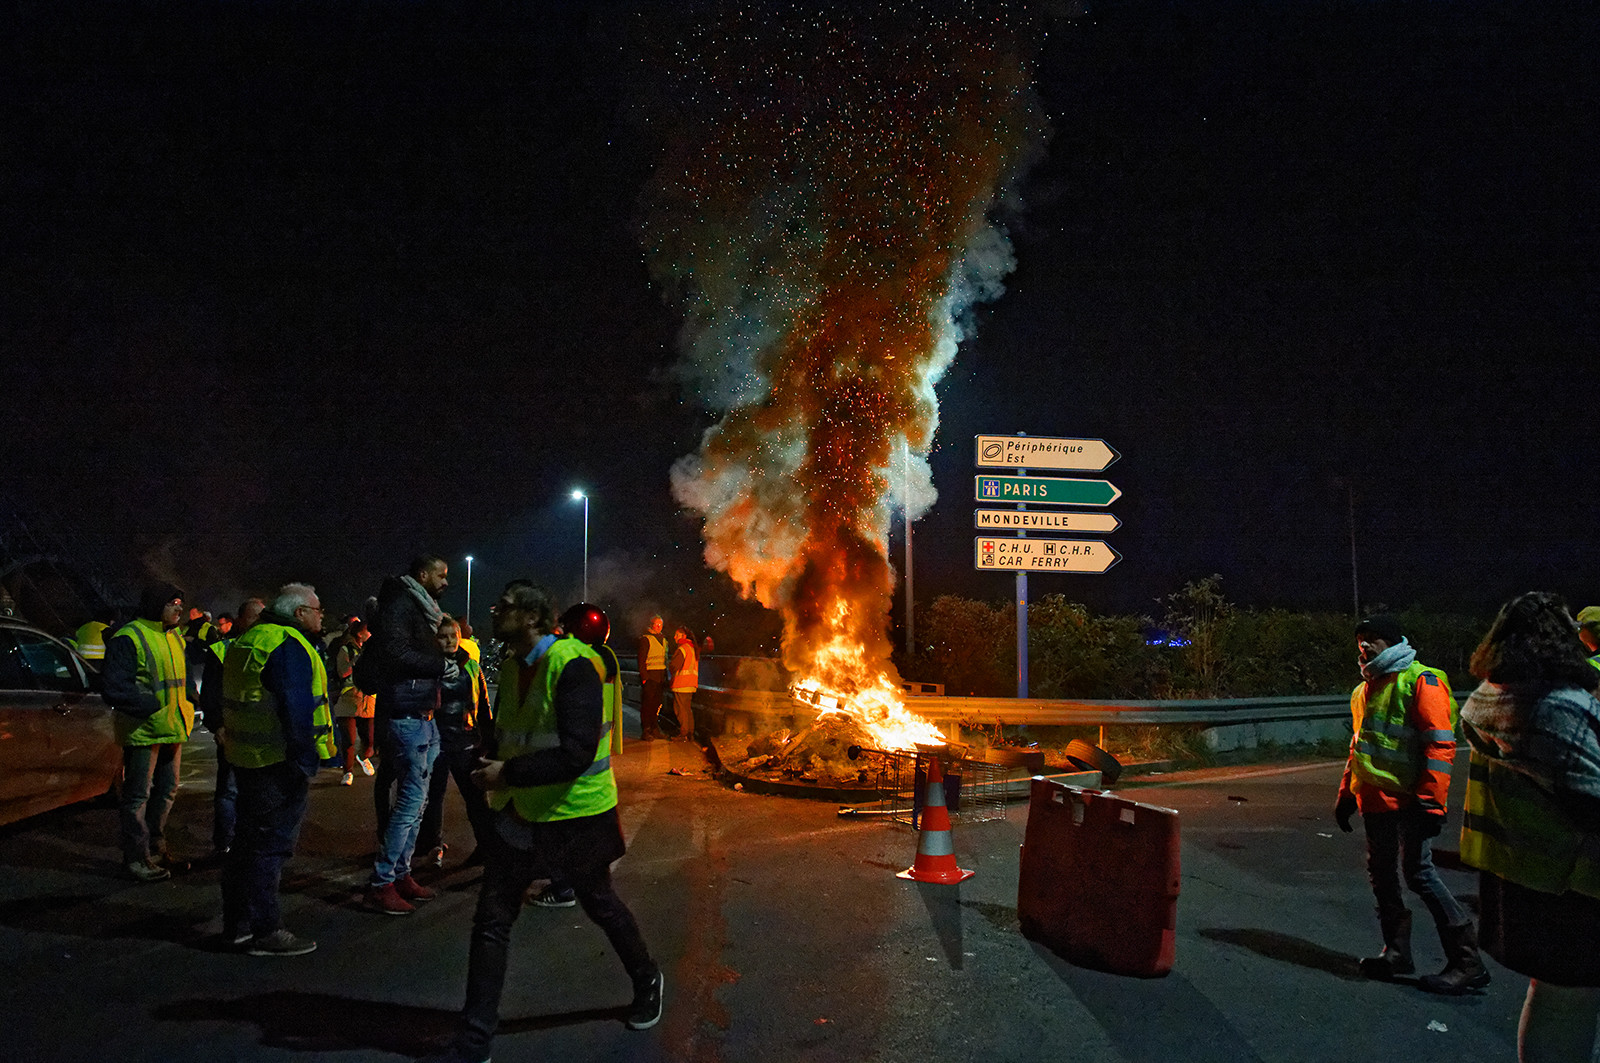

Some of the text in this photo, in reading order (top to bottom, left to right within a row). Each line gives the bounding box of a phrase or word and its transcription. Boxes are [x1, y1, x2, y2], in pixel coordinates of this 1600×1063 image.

[1006, 441, 1084, 455] Périphérique
[1006, 454, 1025, 464] Est
[1003, 483, 1048, 497] PARIS
[981, 514, 1069, 526] MONDEVILLE
[999, 543, 1095, 556] C.H.U. H C.H.R.
[998, 556, 1069, 567] CAR FERRY
